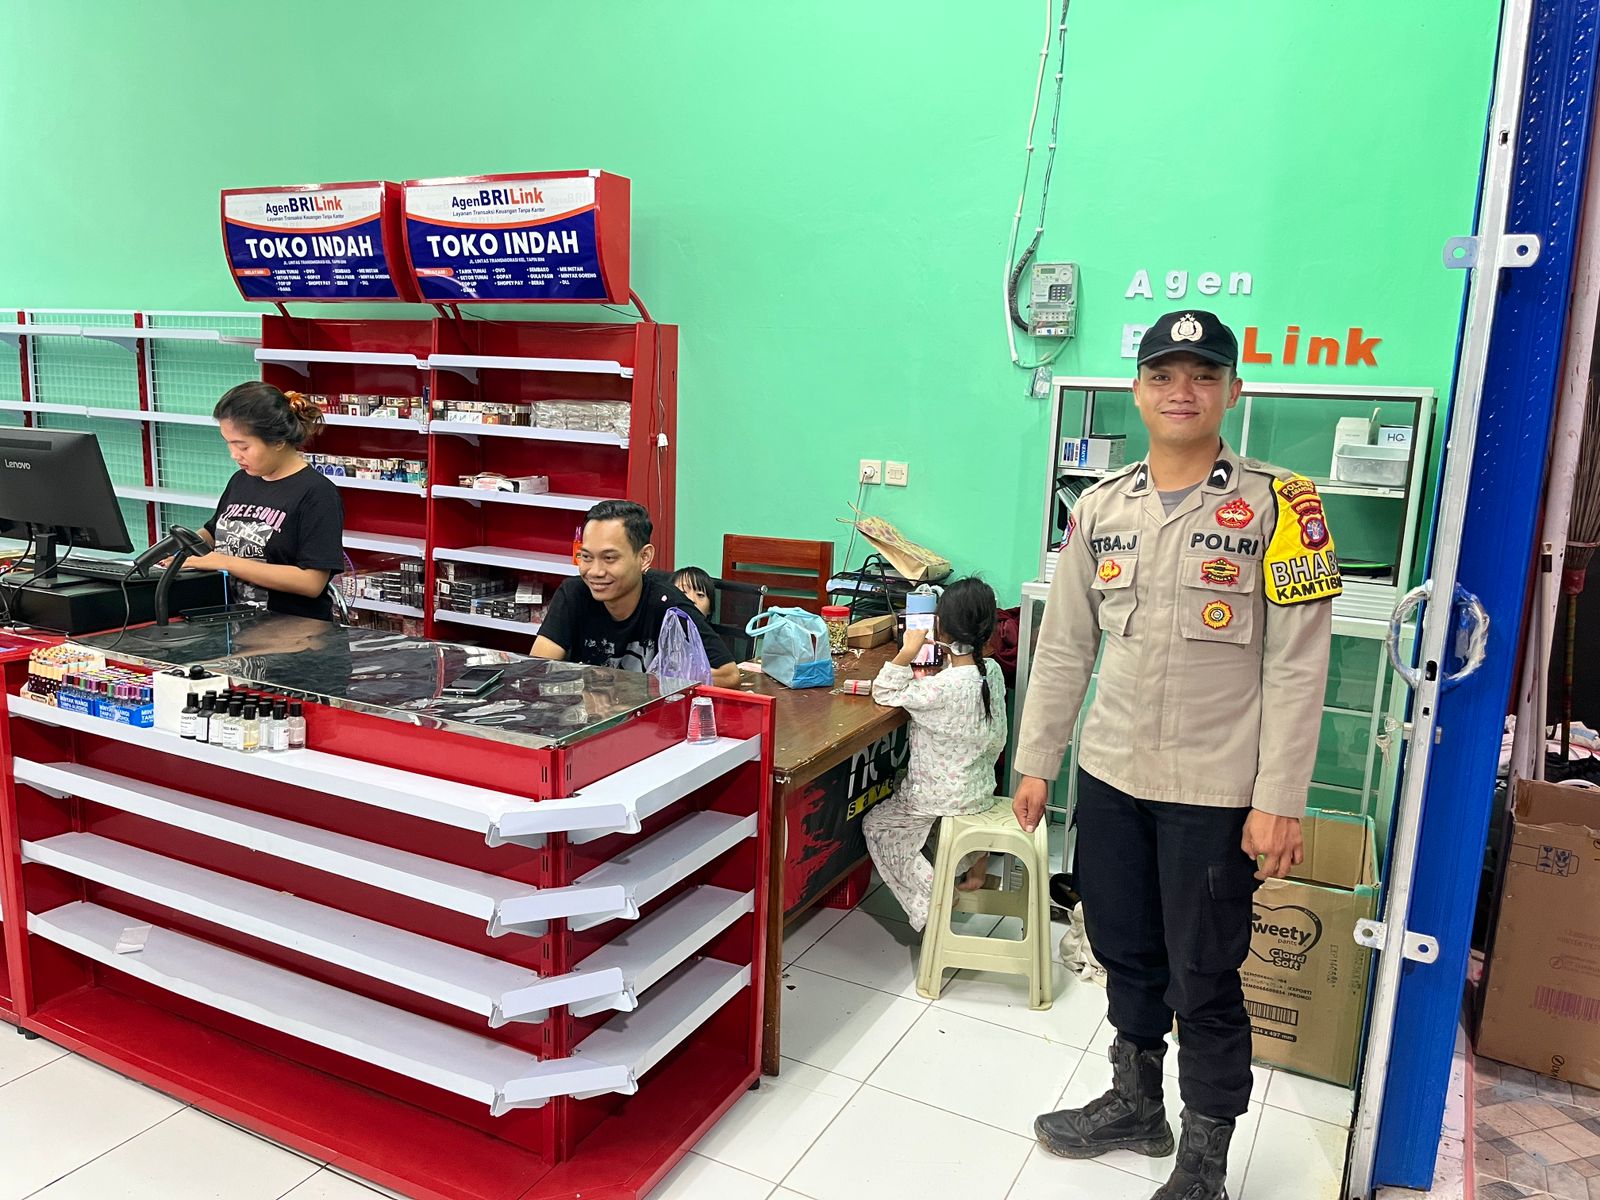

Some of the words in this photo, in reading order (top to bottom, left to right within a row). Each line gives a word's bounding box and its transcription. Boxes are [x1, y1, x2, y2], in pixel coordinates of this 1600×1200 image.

[265, 195, 343, 216] AgenBRILink
[452, 187, 544, 210] AgenBRILink
[245, 236, 308, 259] TOKO
[311, 235, 374, 257] INDAH
[426, 232, 498, 258] TOKO
[504, 230, 579, 255] INDAH
[1124, 268, 1254, 300] Agen
[4, 459, 31, 470] Lenovo
[1190, 532, 1259, 556] POLRI
[1252, 921, 1312, 946] weety
[1277, 938, 1297, 947] pants
[1269, 948, 1307, 964] Cloud
[1273, 957, 1301, 971] Soft
